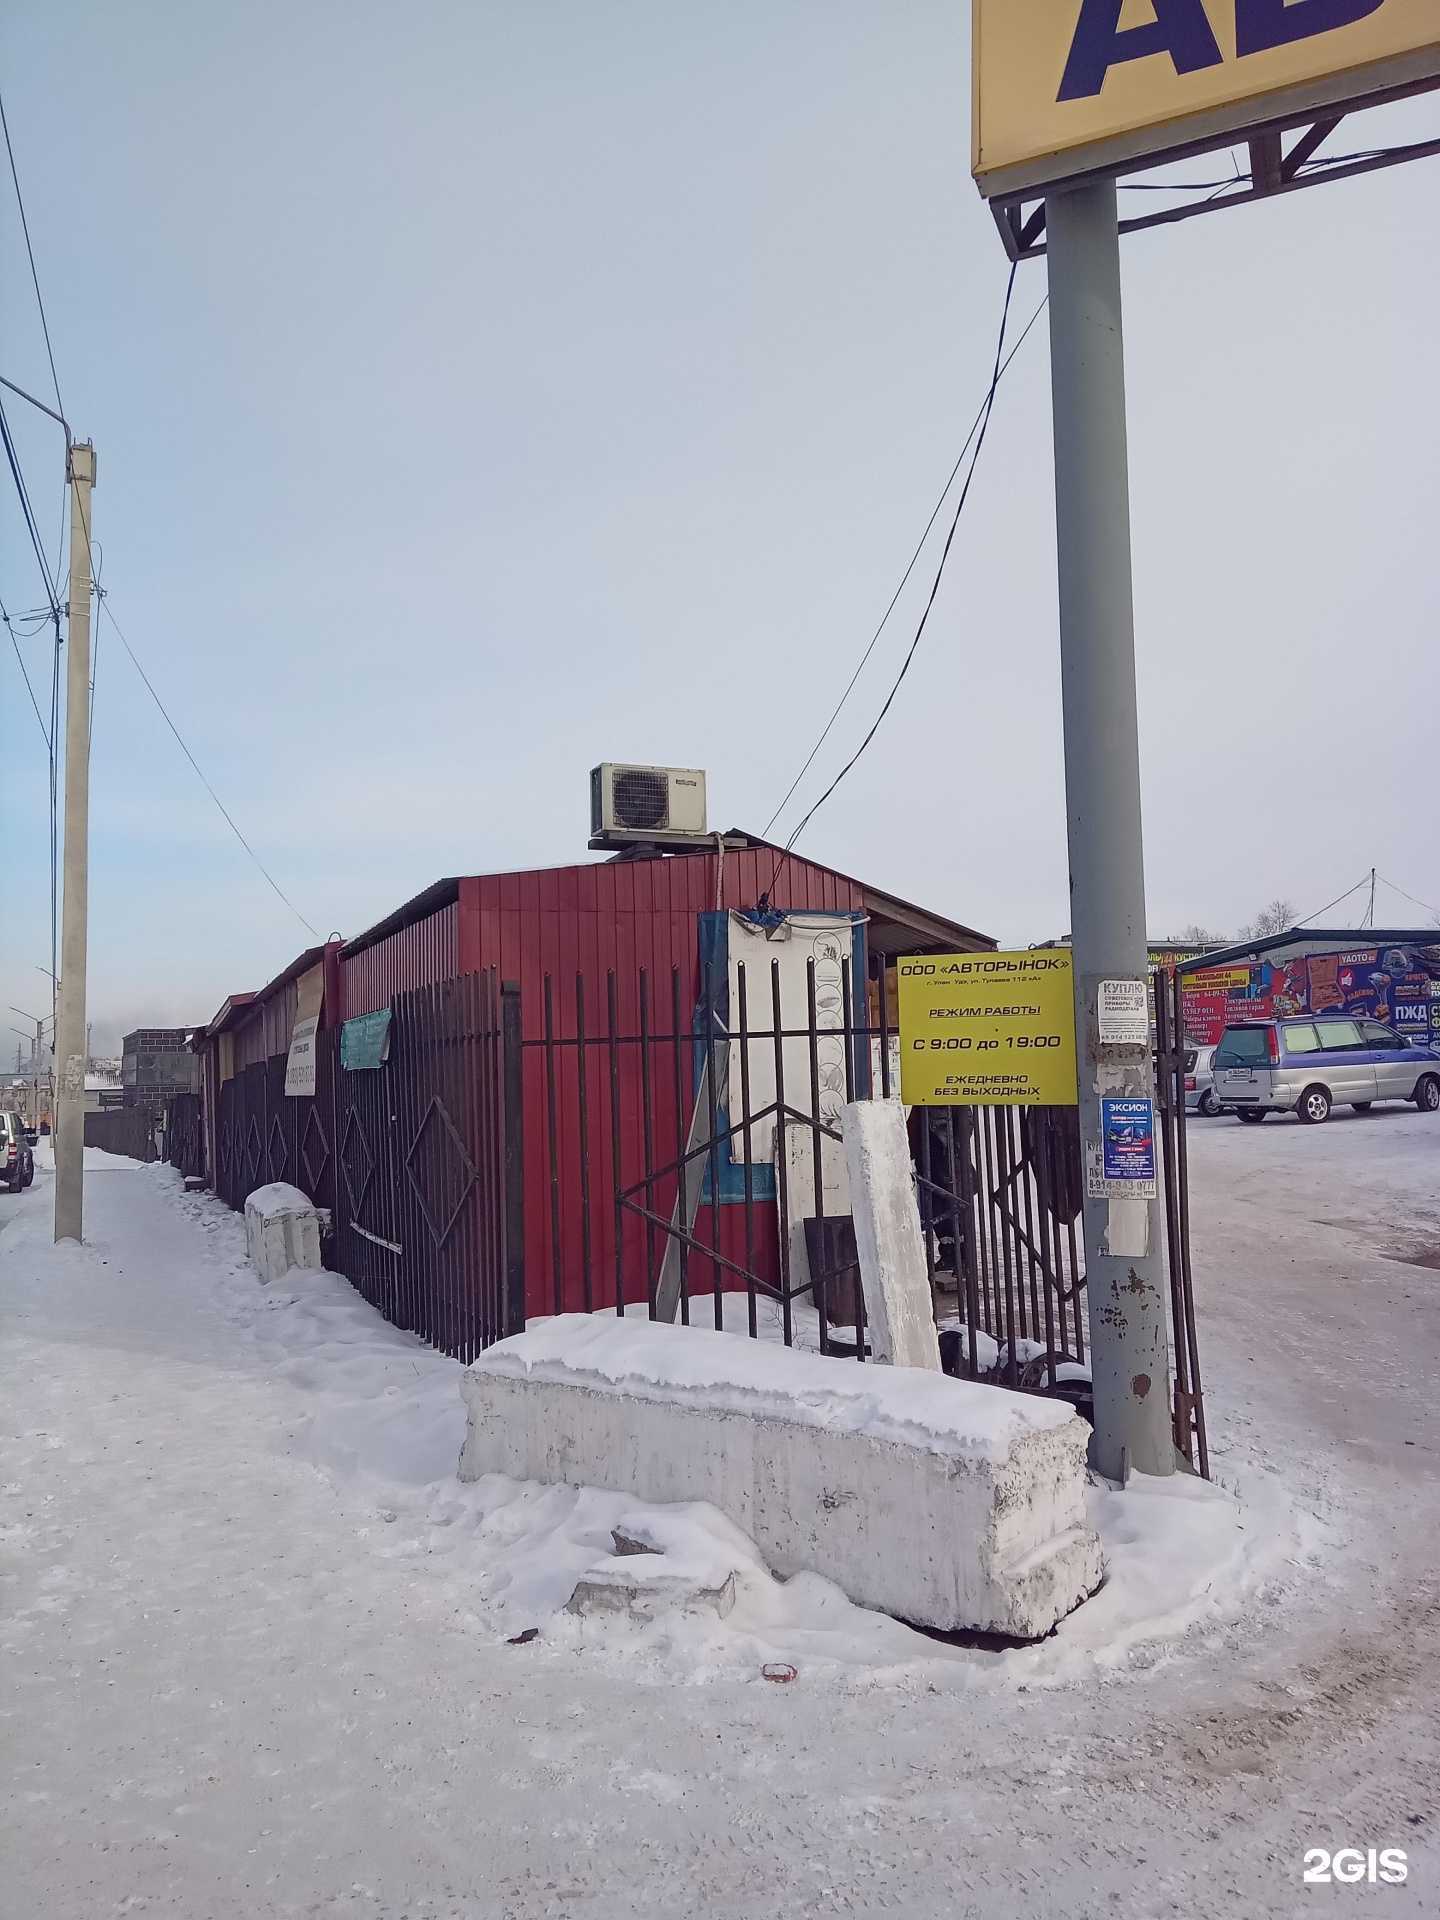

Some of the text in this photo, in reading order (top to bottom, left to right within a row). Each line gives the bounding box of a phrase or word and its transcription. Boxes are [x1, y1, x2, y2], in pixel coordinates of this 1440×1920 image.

[900, 958, 1070, 976] ООО «АВТОРЫНОК»
[1103, 983, 1143, 994] КУПЛЮ
[929, 1006, 1041, 1017] РЕЖИМ РАБОТЫ
[1395, 1004, 1428, 1020] ПЖД
[913, 1036, 1061, 1051] С 9:00 до 19:00
[945, 1075, 1029, 1084] ЕЖЕДНЕВНО
[934, 1087, 1041, 1096] БЕЗ ВЫХОДНЫХ
[1108, 1103, 1148, 1112] ЭКСИОН
